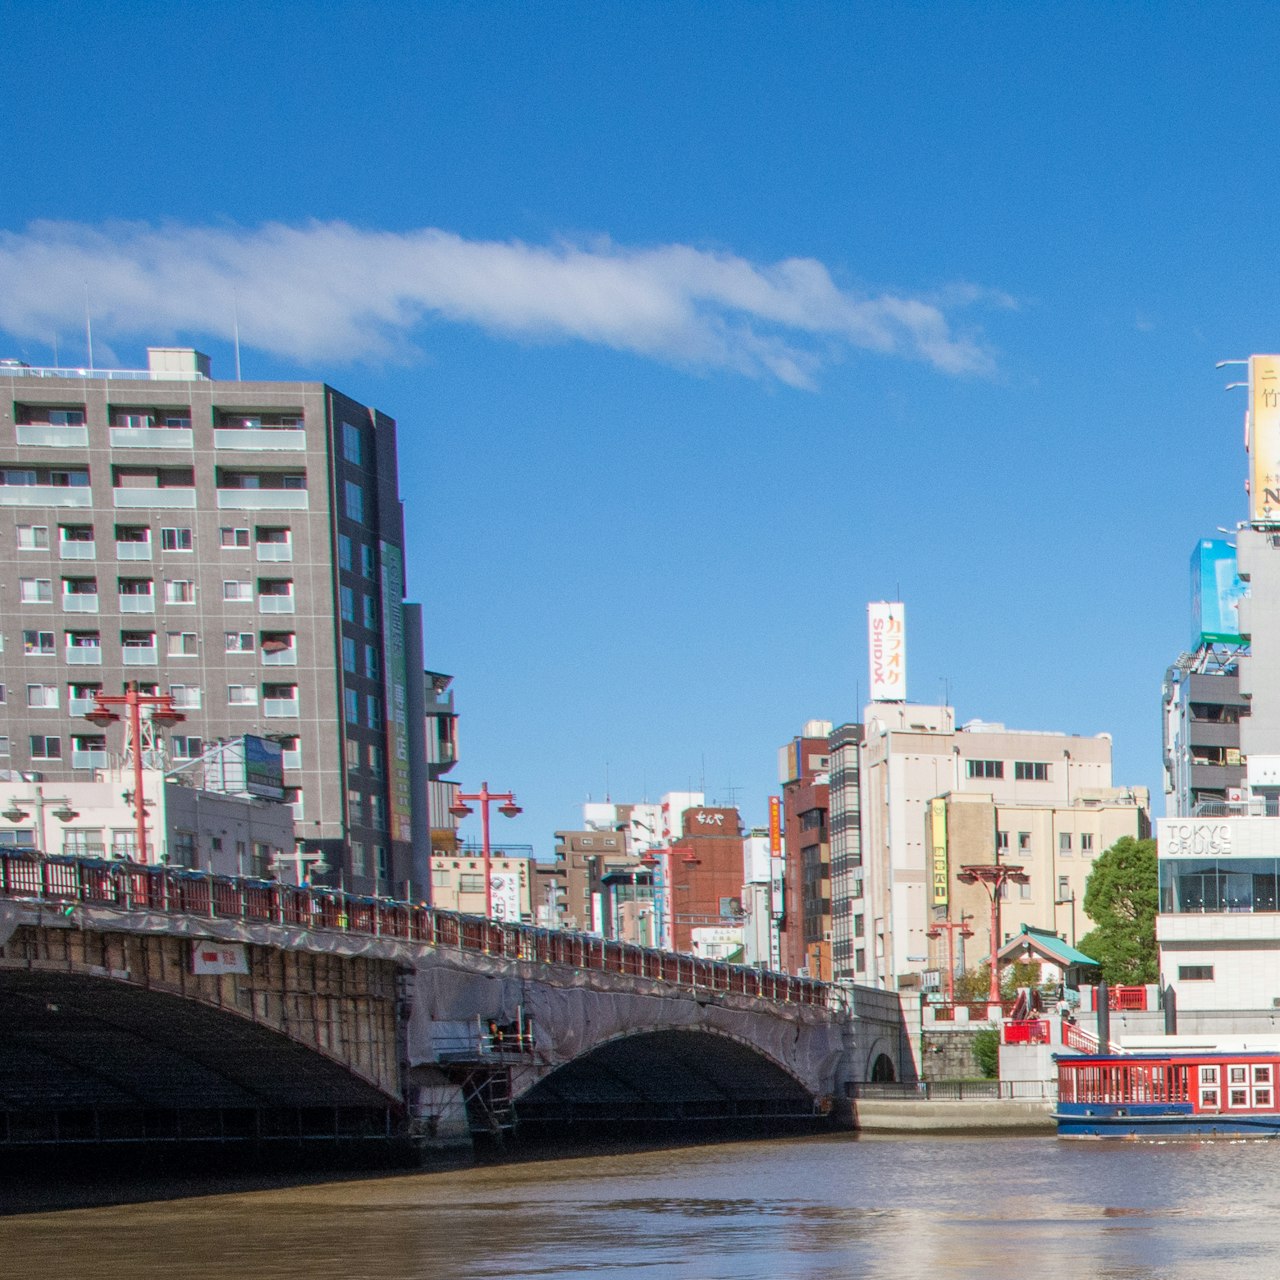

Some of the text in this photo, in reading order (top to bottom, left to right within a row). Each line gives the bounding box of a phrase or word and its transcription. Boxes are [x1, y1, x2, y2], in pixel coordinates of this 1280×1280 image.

[873, 617, 885, 684] SHIDAX
[886, 618, 902, 685] カラオケ
[1167, 825, 1231, 840] TOKYO
[1168, 841, 1231, 855] CRUISE
